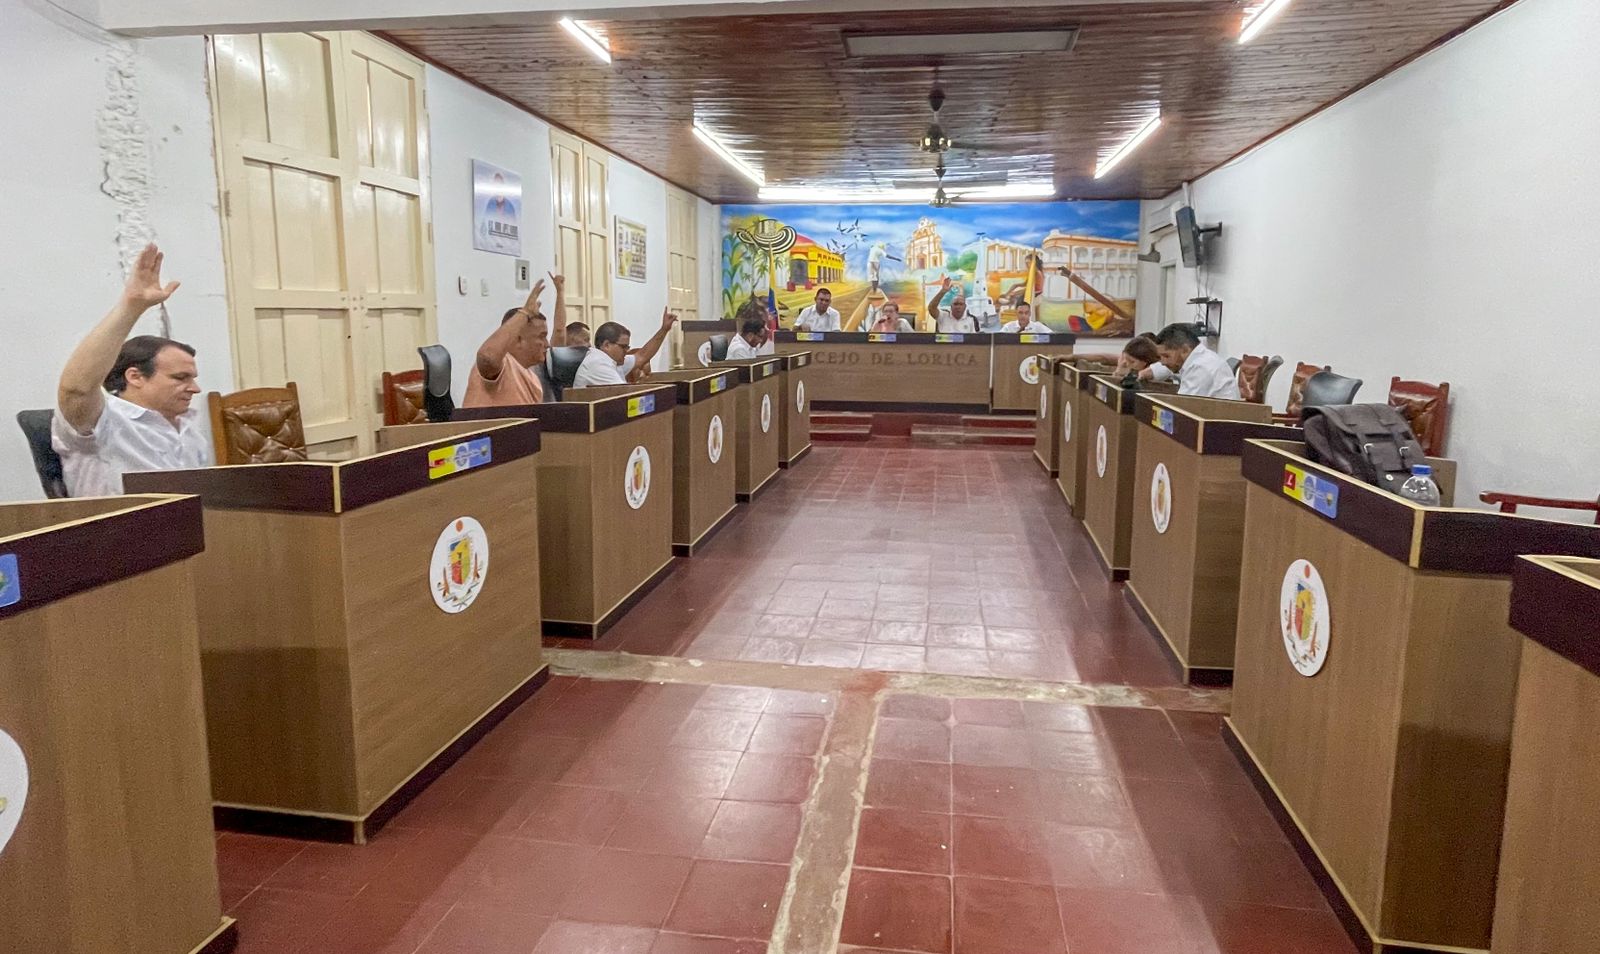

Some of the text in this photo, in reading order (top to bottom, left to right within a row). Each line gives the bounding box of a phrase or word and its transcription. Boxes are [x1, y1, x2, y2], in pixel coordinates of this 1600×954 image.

[815, 352, 978, 366] CEJO DE LORICA
